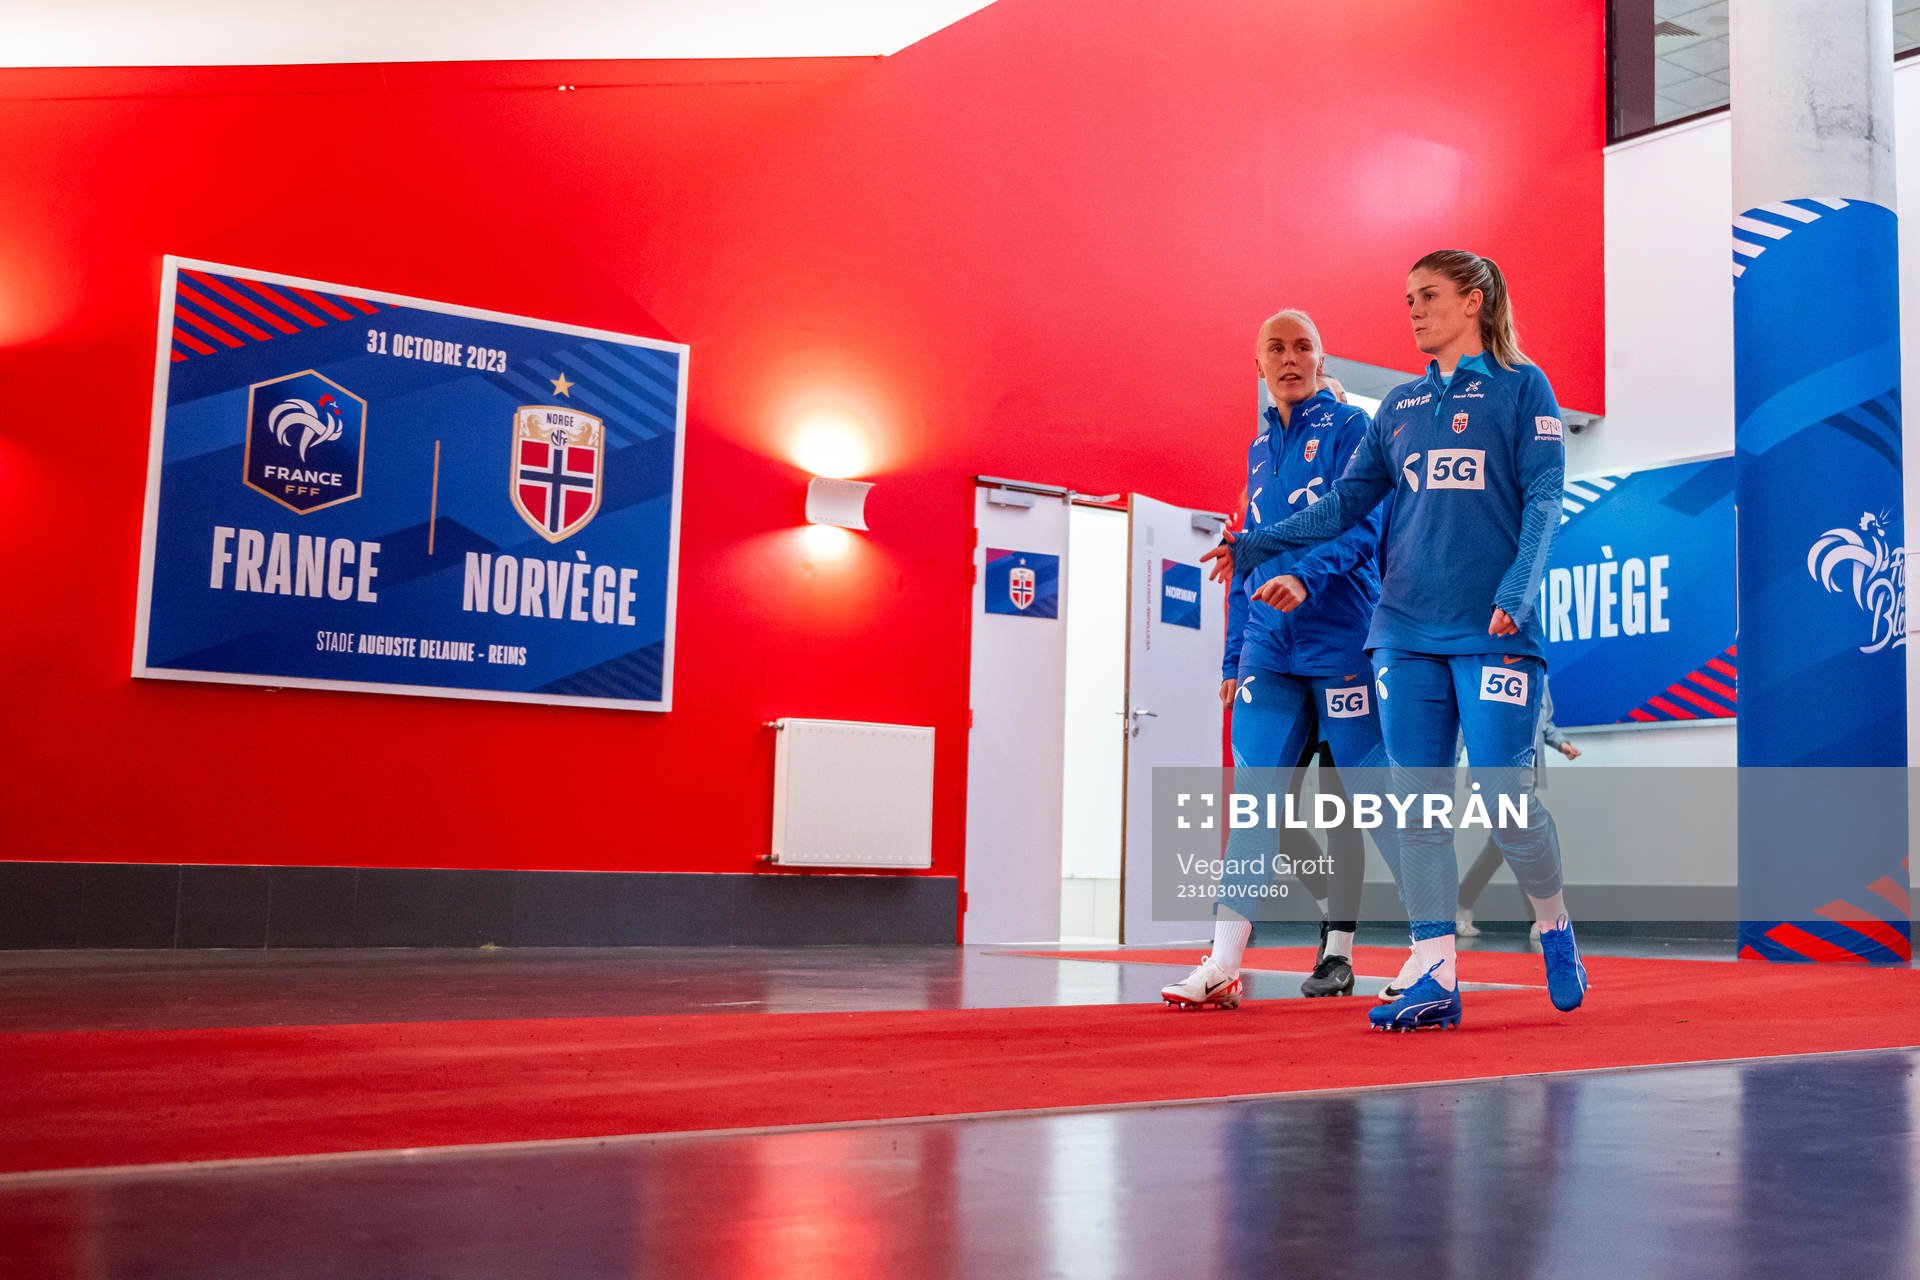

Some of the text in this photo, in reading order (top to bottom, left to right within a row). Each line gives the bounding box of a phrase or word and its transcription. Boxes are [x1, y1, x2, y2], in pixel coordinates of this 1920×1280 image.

[367, 329, 507, 373] 31 OCTOBRE 2023
[1396, 396, 1421, 410] KIWI
[546, 412, 575, 428] NORGE
[264, 465, 343, 487] FRANCE
[1432, 457, 1478, 482] 5G
[285, 484, 321, 497] FFF
[209, 526, 381, 603] FRANCE
[461, 550, 639, 626] NORVÈGE
[1165, 585, 1197, 603] NORWAY
[1540, 545, 1670, 643] RVÈGE
[316, 631, 355, 653] STADE
[358, 634, 416, 658] AUGUSTE
[419, 639, 475, 662] DELAUNE
[488, 644, 527, 666] REIMS
[1486, 674, 1524, 698] 5G
[1330, 693, 1364, 713] 5G
